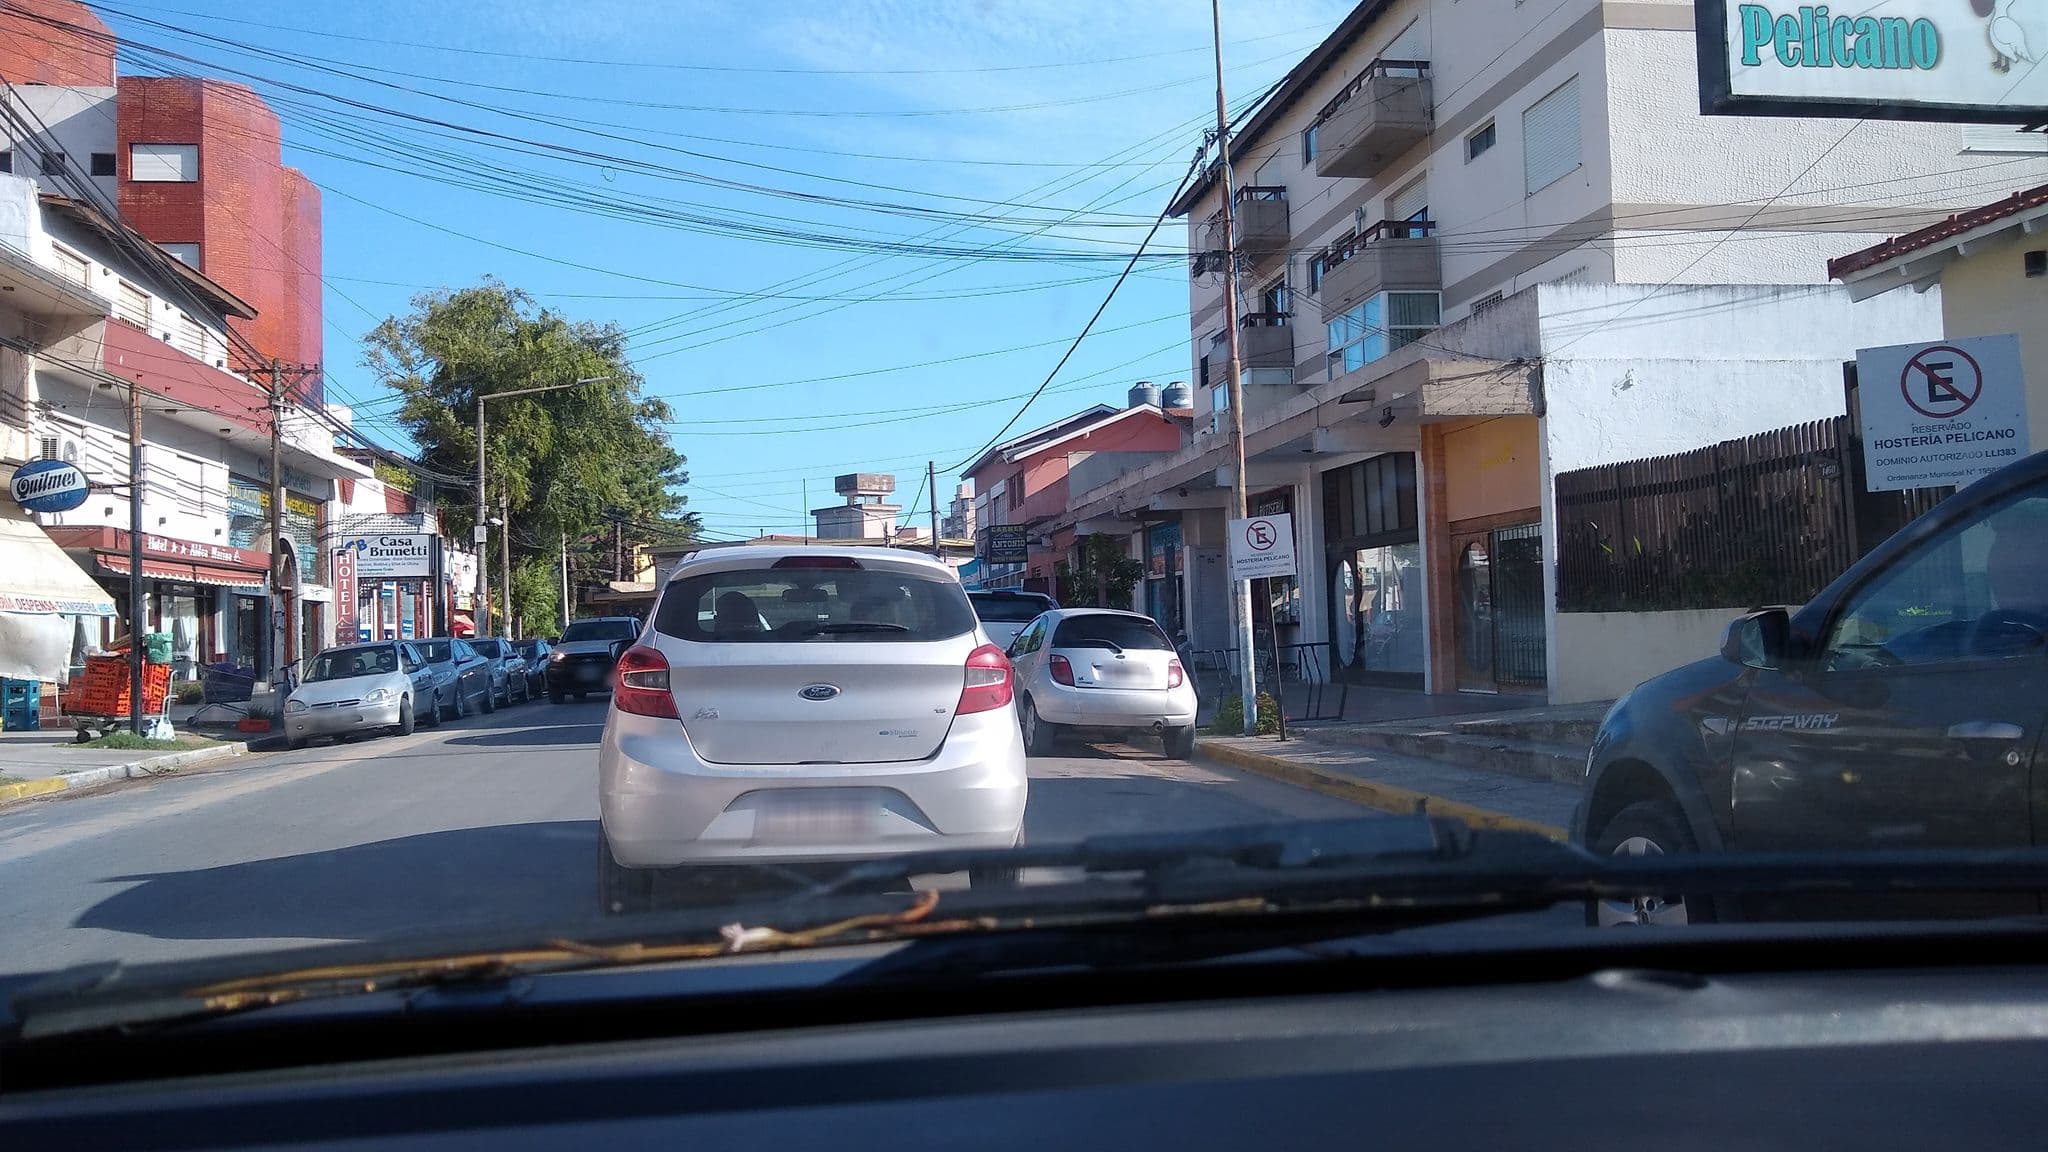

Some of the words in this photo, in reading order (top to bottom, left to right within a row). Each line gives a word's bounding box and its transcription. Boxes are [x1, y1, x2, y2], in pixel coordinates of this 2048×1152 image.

[1739, 4, 1938, 70] Pelicano
[1912, 421, 1971, 434] RESERVADO
[1874, 433, 1943, 450] HOSTERÍA
[1946, 428, 2016, 444] PELICANO
[1876, 456, 1918, 467] DOMINIO
[1919, 451, 1983, 463] AUTORIZADO
[1887, 473, 1928, 482] Ordenanza
[1929, 470, 1965, 479] Municipal
[16, 470, 77, 500] Quilmes
[379, 536, 413, 547] Casa
[991, 539, 1026, 548] ANTONIO
[369, 546, 428, 557] Brunetti
[338, 553, 351, 616] HOTEL
[1745, 712, 1840, 732] STEPWAY
